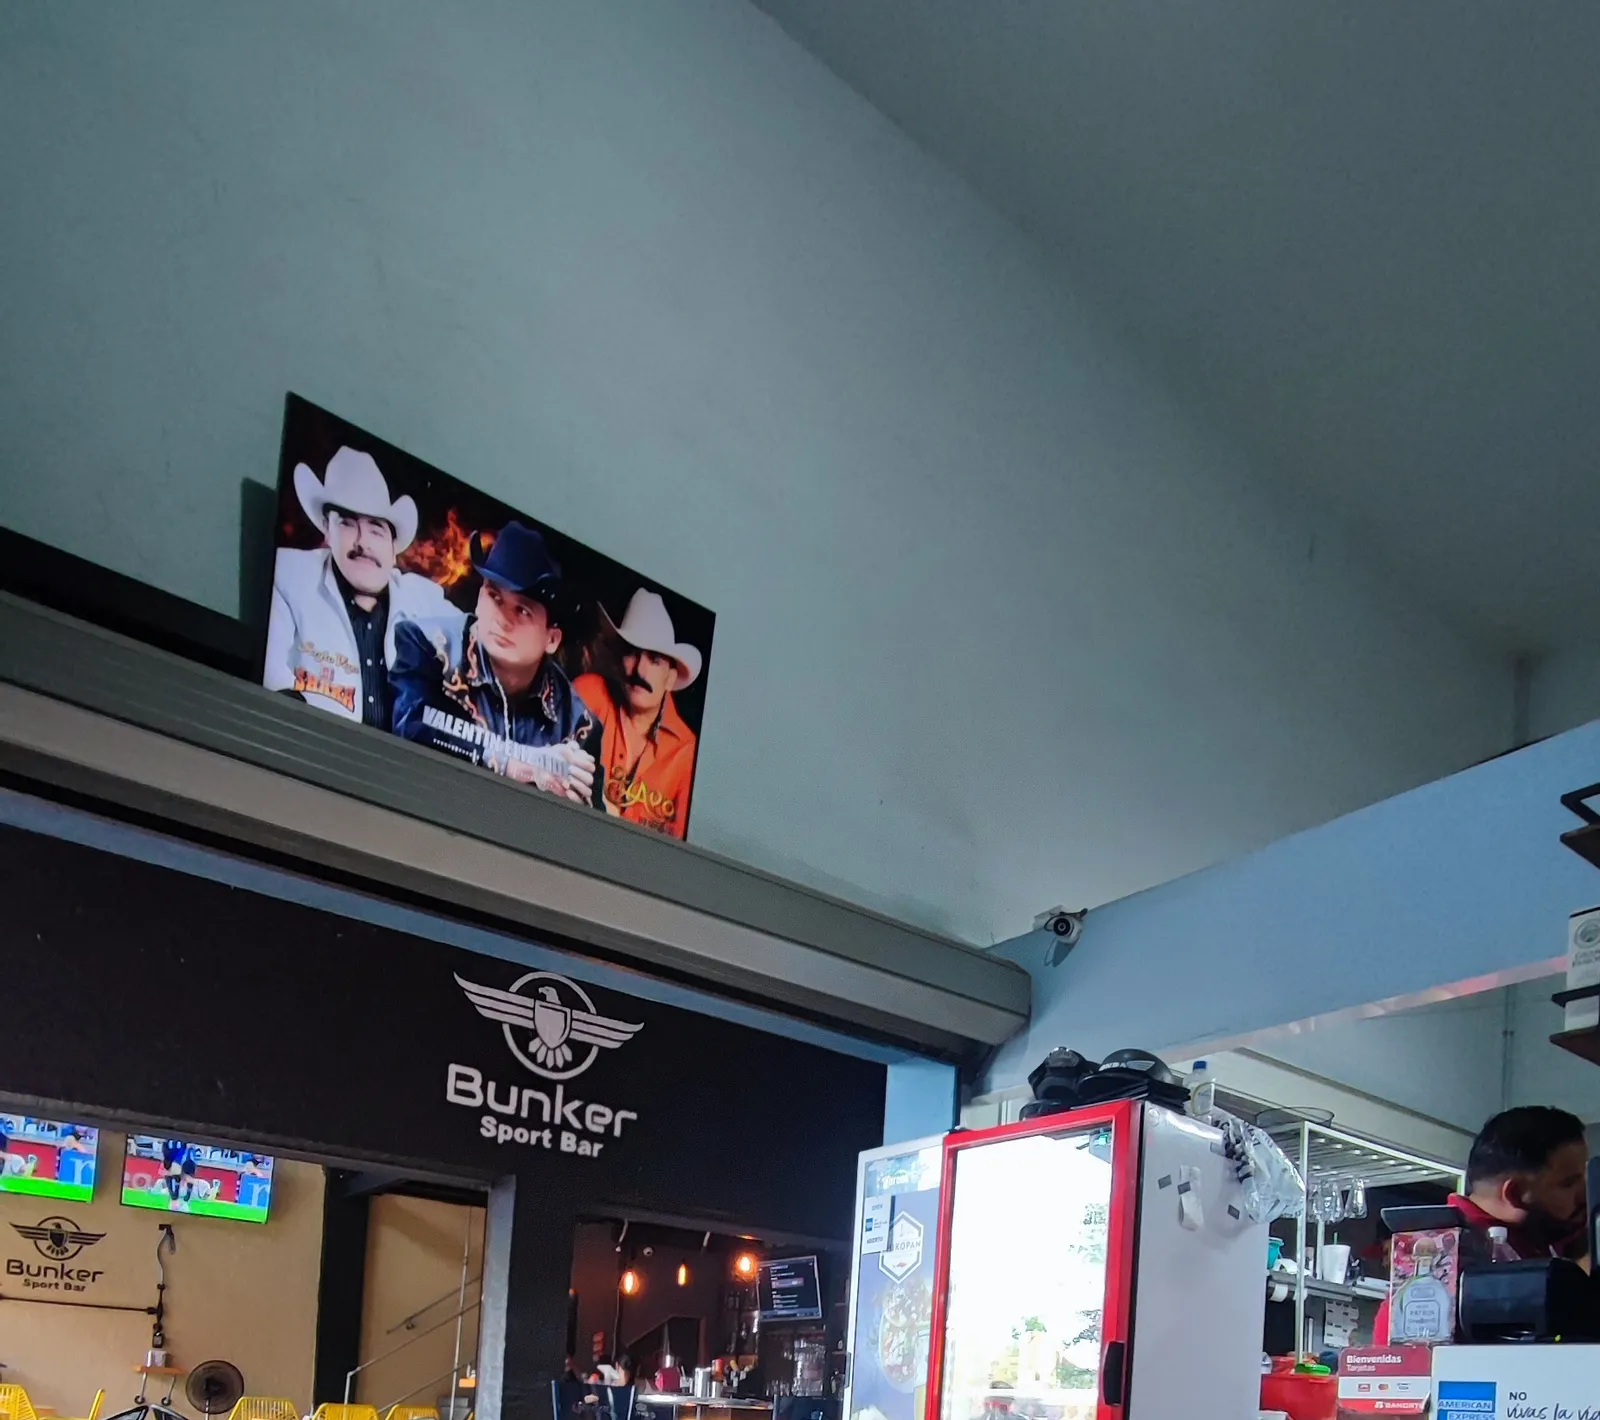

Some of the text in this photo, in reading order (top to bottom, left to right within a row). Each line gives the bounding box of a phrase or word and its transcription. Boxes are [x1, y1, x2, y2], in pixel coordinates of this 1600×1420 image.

[446, 1063, 638, 1137] Bunker
[480, 1115, 604, 1158] Sport Bar
[6, 1259, 104, 1283] Bunker
[23, 1278, 86, 1292] Sport Bar
[1346, 1354, 1402, 1364] Bienvenidas
[1509, 1391, 1528, 1401] NO
[1438, 1400, 1491, 1410] AMERICAN
[1506, 1403, 1549, 1420] vivas
